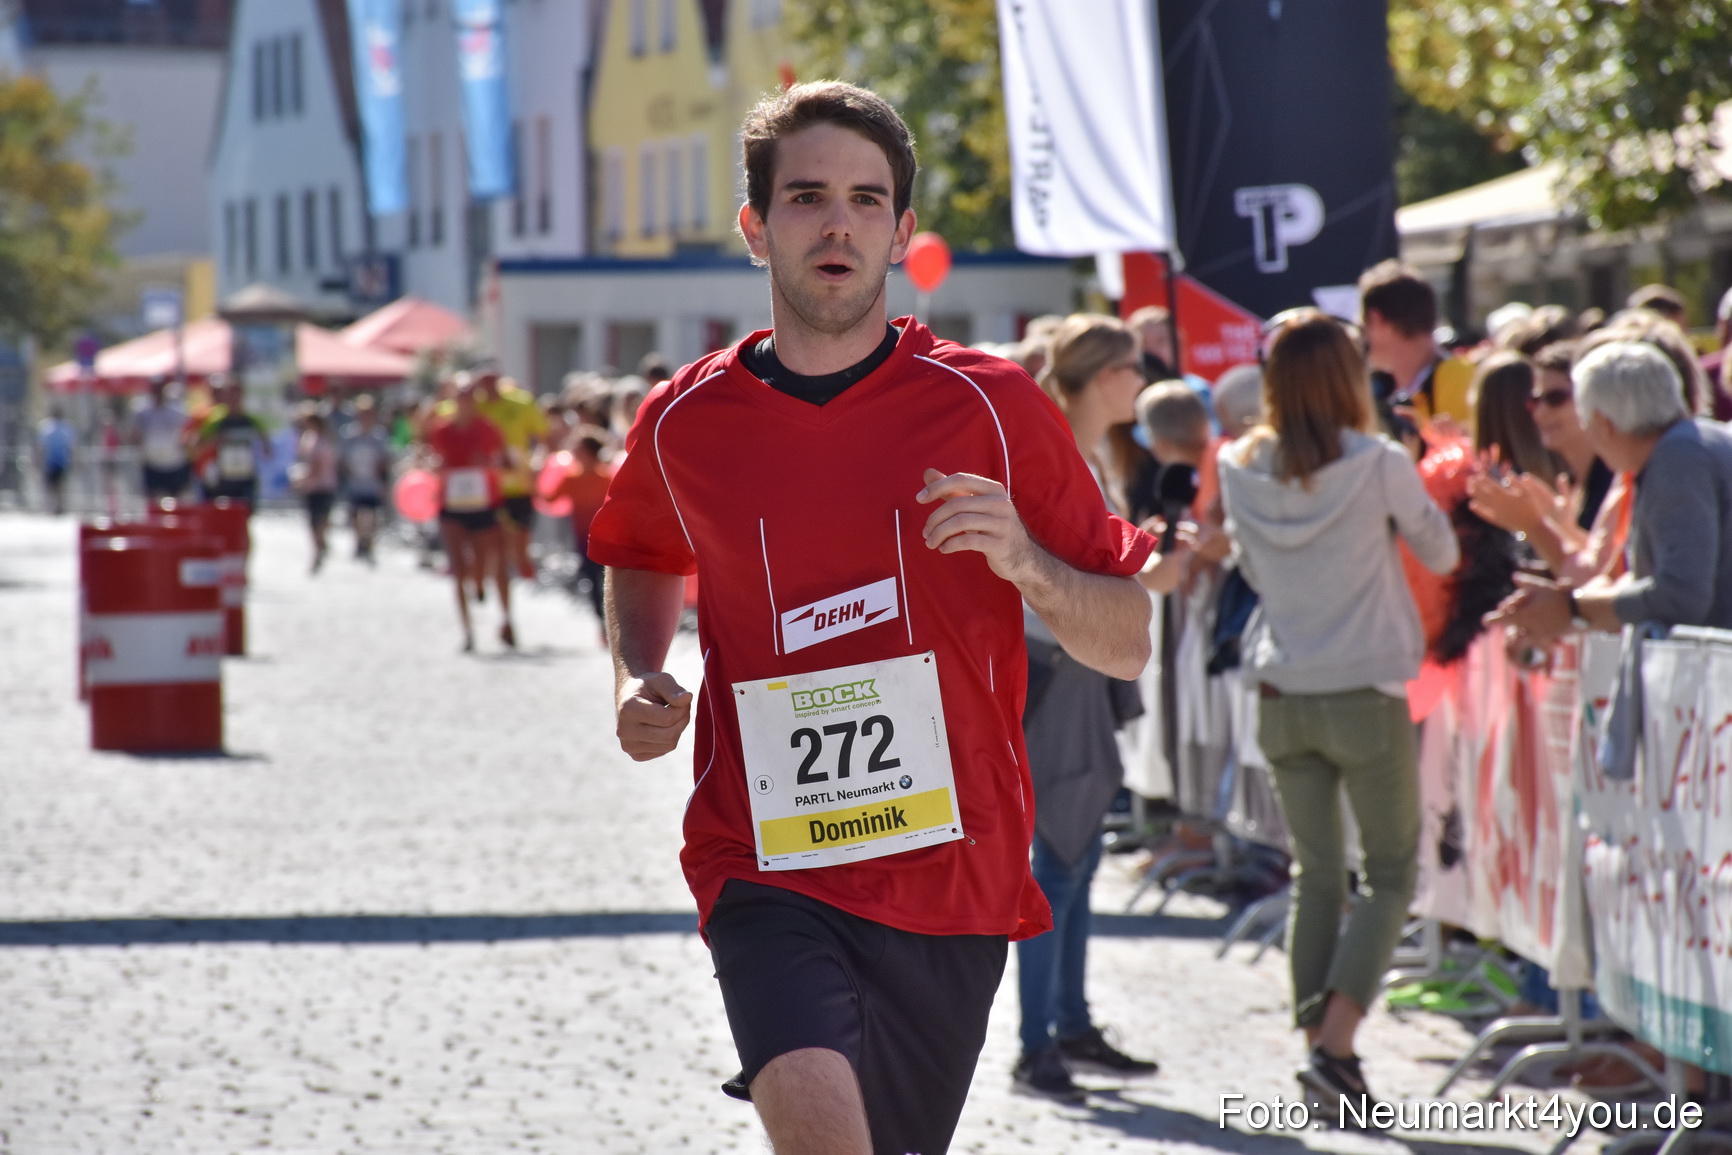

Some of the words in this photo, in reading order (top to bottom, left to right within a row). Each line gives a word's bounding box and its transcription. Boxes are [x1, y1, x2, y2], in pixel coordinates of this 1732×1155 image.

[813, 599, 866, 632] DEHN
[791, 678, 880, 711] BOCK
[795, 709, 820, 718] inspired
[831, 704, 851, 713] smart
[790, 714, 901, 785] 272
[760, 780, 768, 791] B
[795, 792, 835, 807] PARTL
[837, 780, 896, 801] Neumarkt
[809, 806, 908, 844] Dominik
